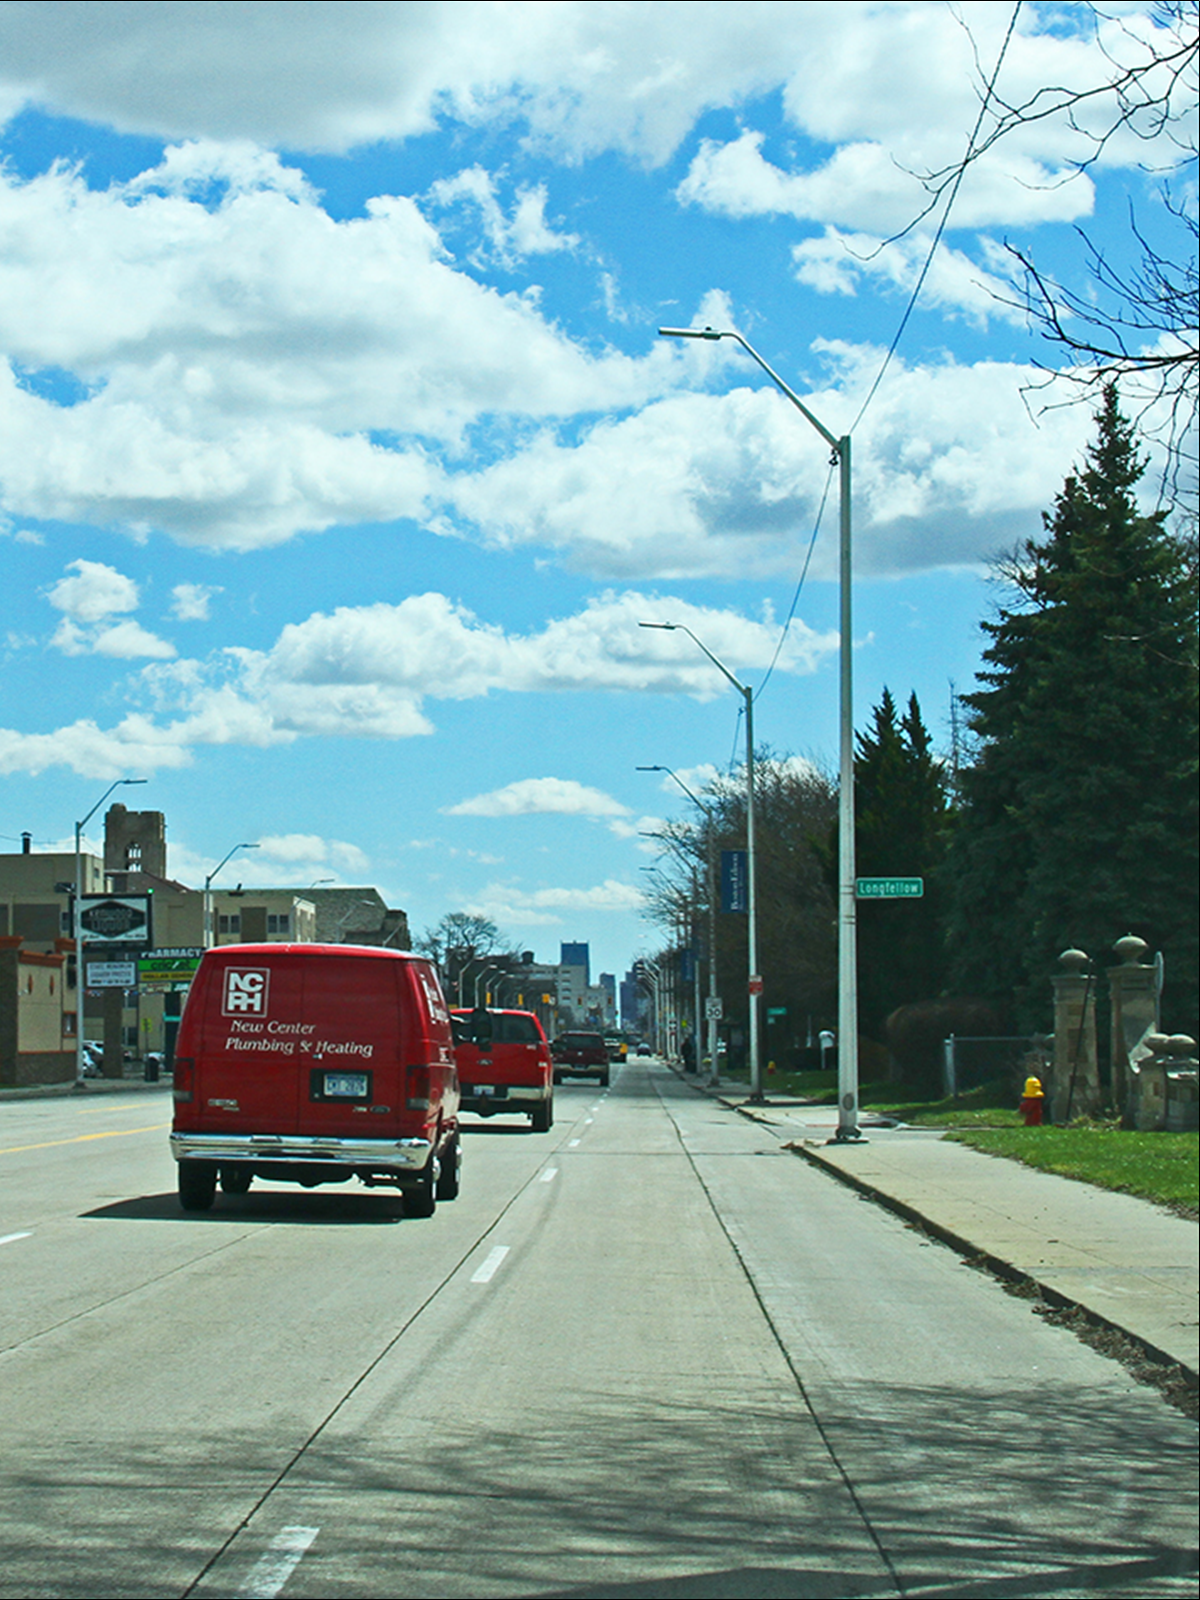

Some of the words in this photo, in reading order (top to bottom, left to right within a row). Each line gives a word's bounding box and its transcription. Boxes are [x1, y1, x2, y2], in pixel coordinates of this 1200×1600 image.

[859, 882, 919, 896] Longfellow
[706, 1008, 721, 1017] 30
[230, 1020, 264, 1033] New
[267, 1020, 316, 1034] Center
[225, 1037, 294, 1055] Plumbing
[300, 1040, 312, 1052] &
[315, 1041, 373, 1058] Heating
